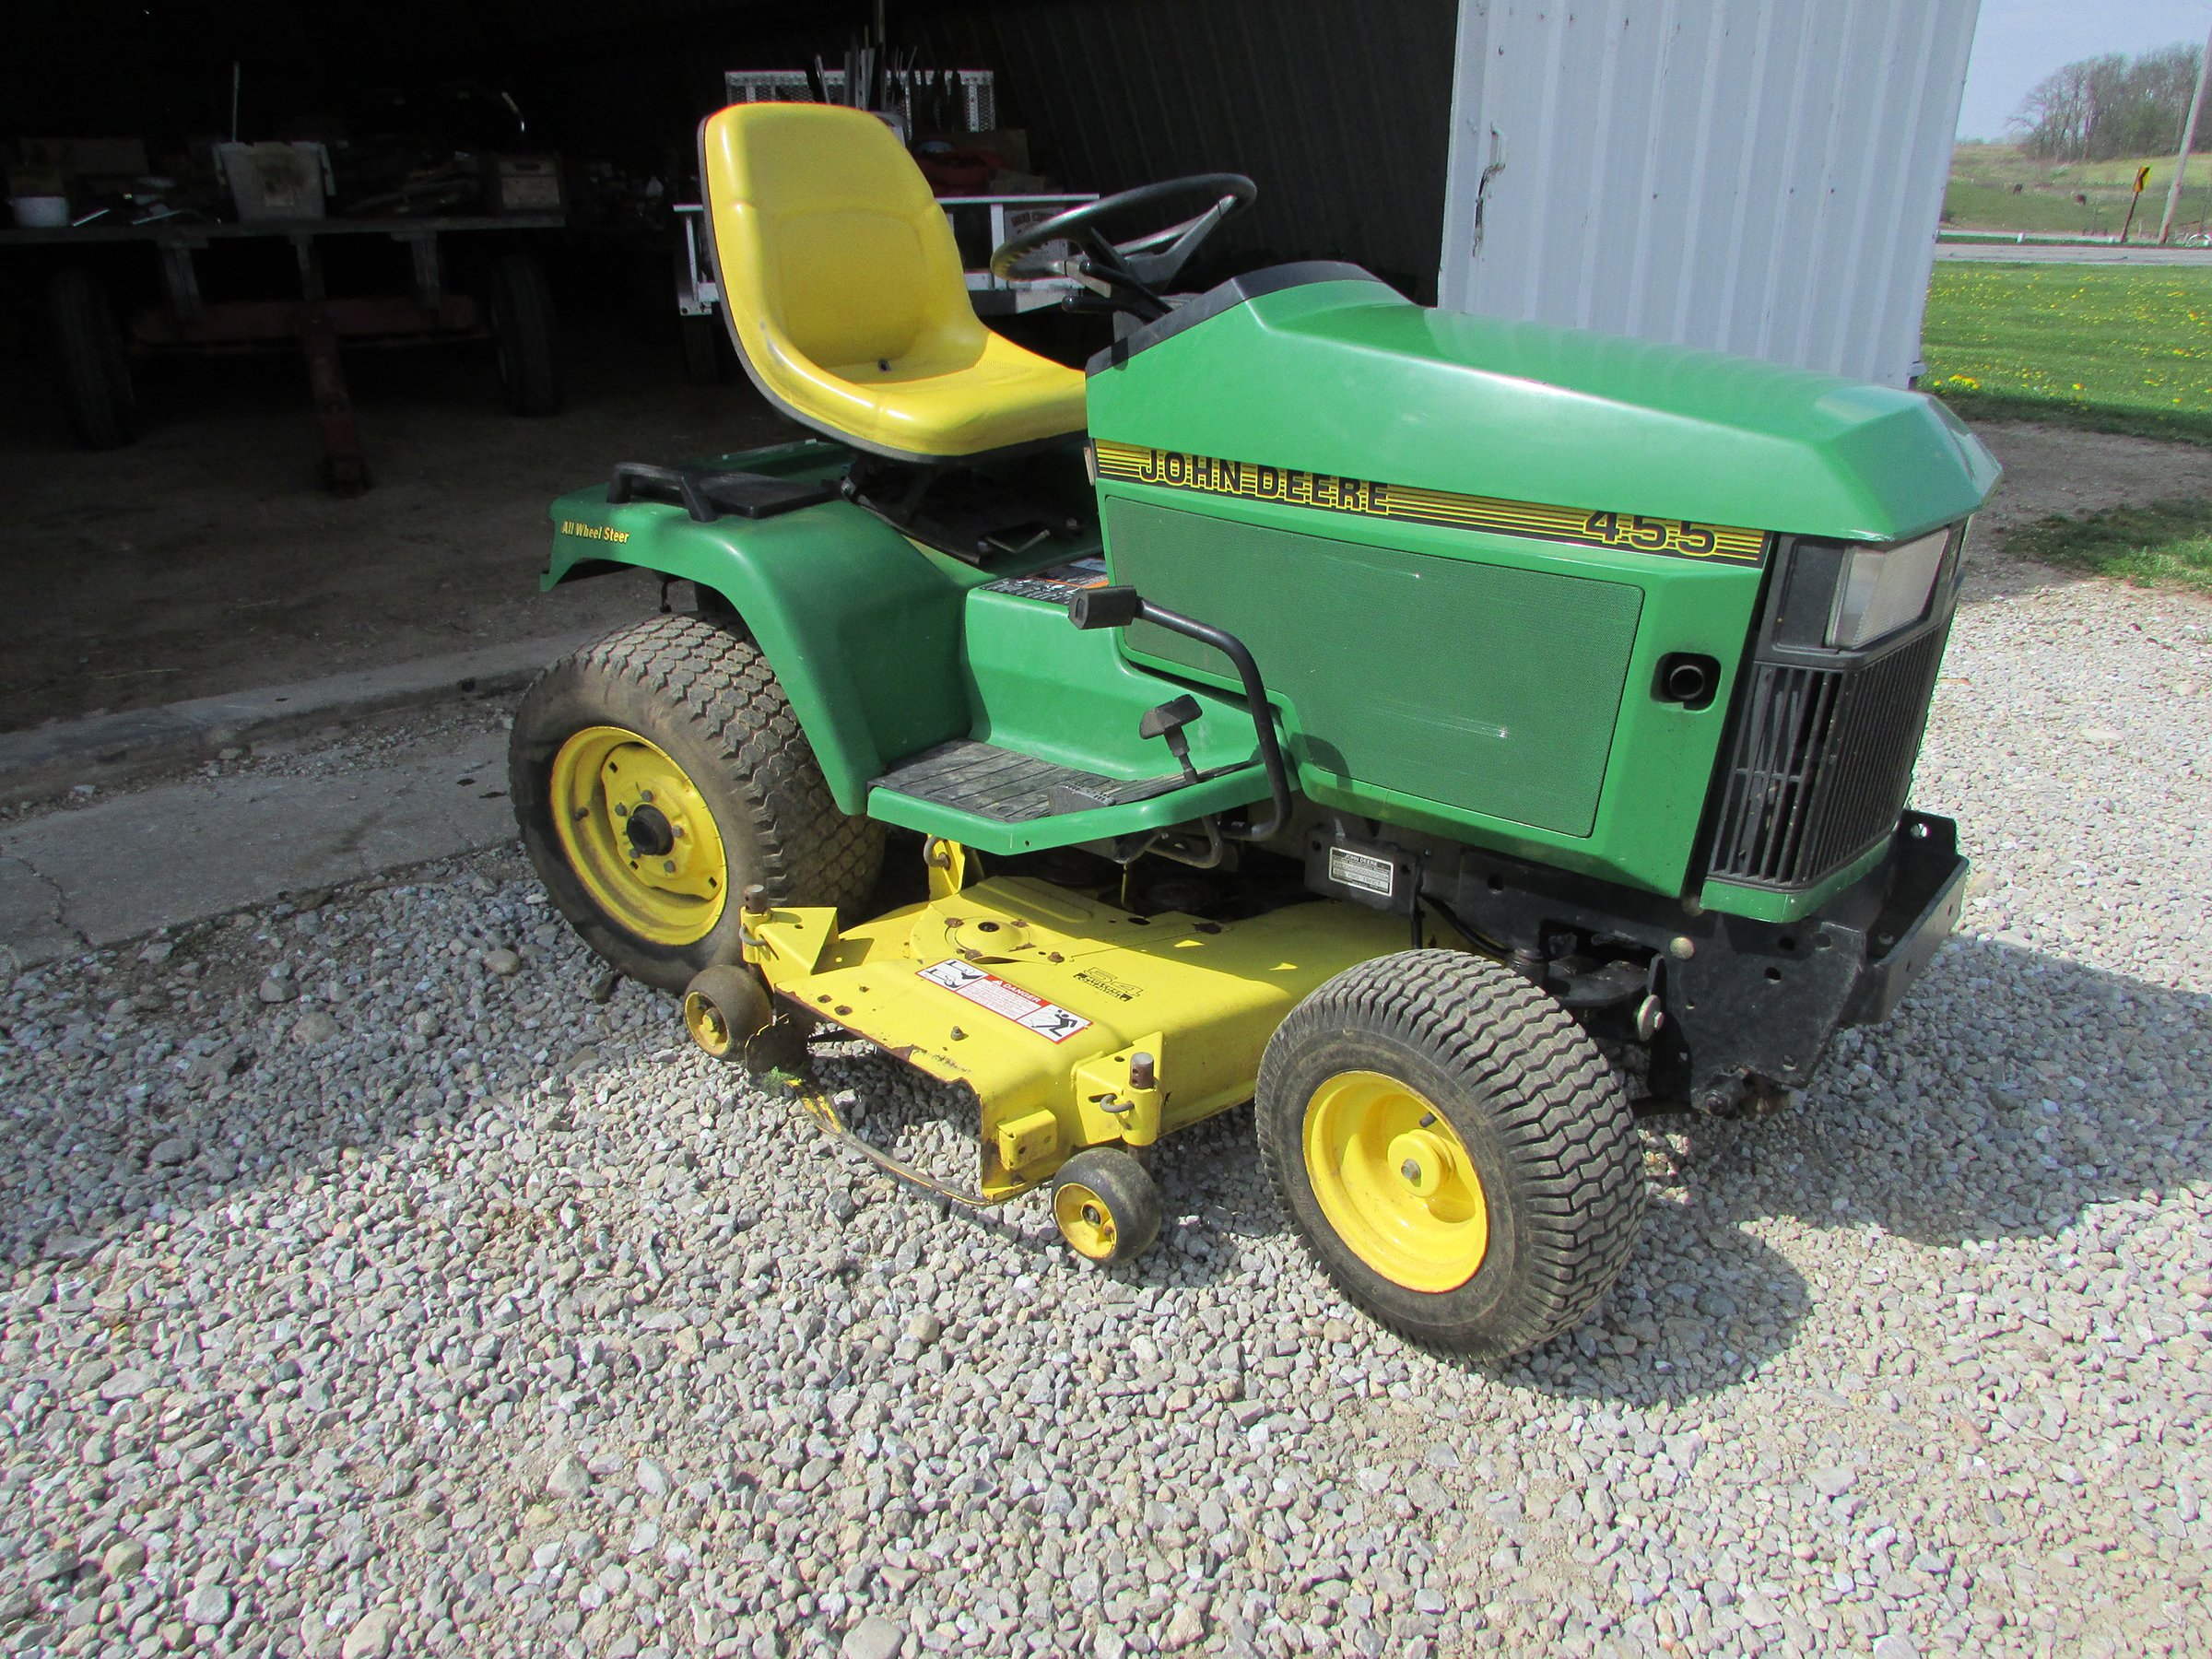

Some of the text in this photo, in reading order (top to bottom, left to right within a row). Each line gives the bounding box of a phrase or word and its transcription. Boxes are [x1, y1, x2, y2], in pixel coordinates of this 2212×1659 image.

[1139, 449, 1389, 515] JOHN DEERE
[561, 522, 629, 543] All Wheel Steer
[1583, 510, 1718, 558] 455
[1359, 857, 1377, 866] DEERE
[1002, 982, 1041, 1004] DANGER
[1084, 967, 1144, 996] 54
